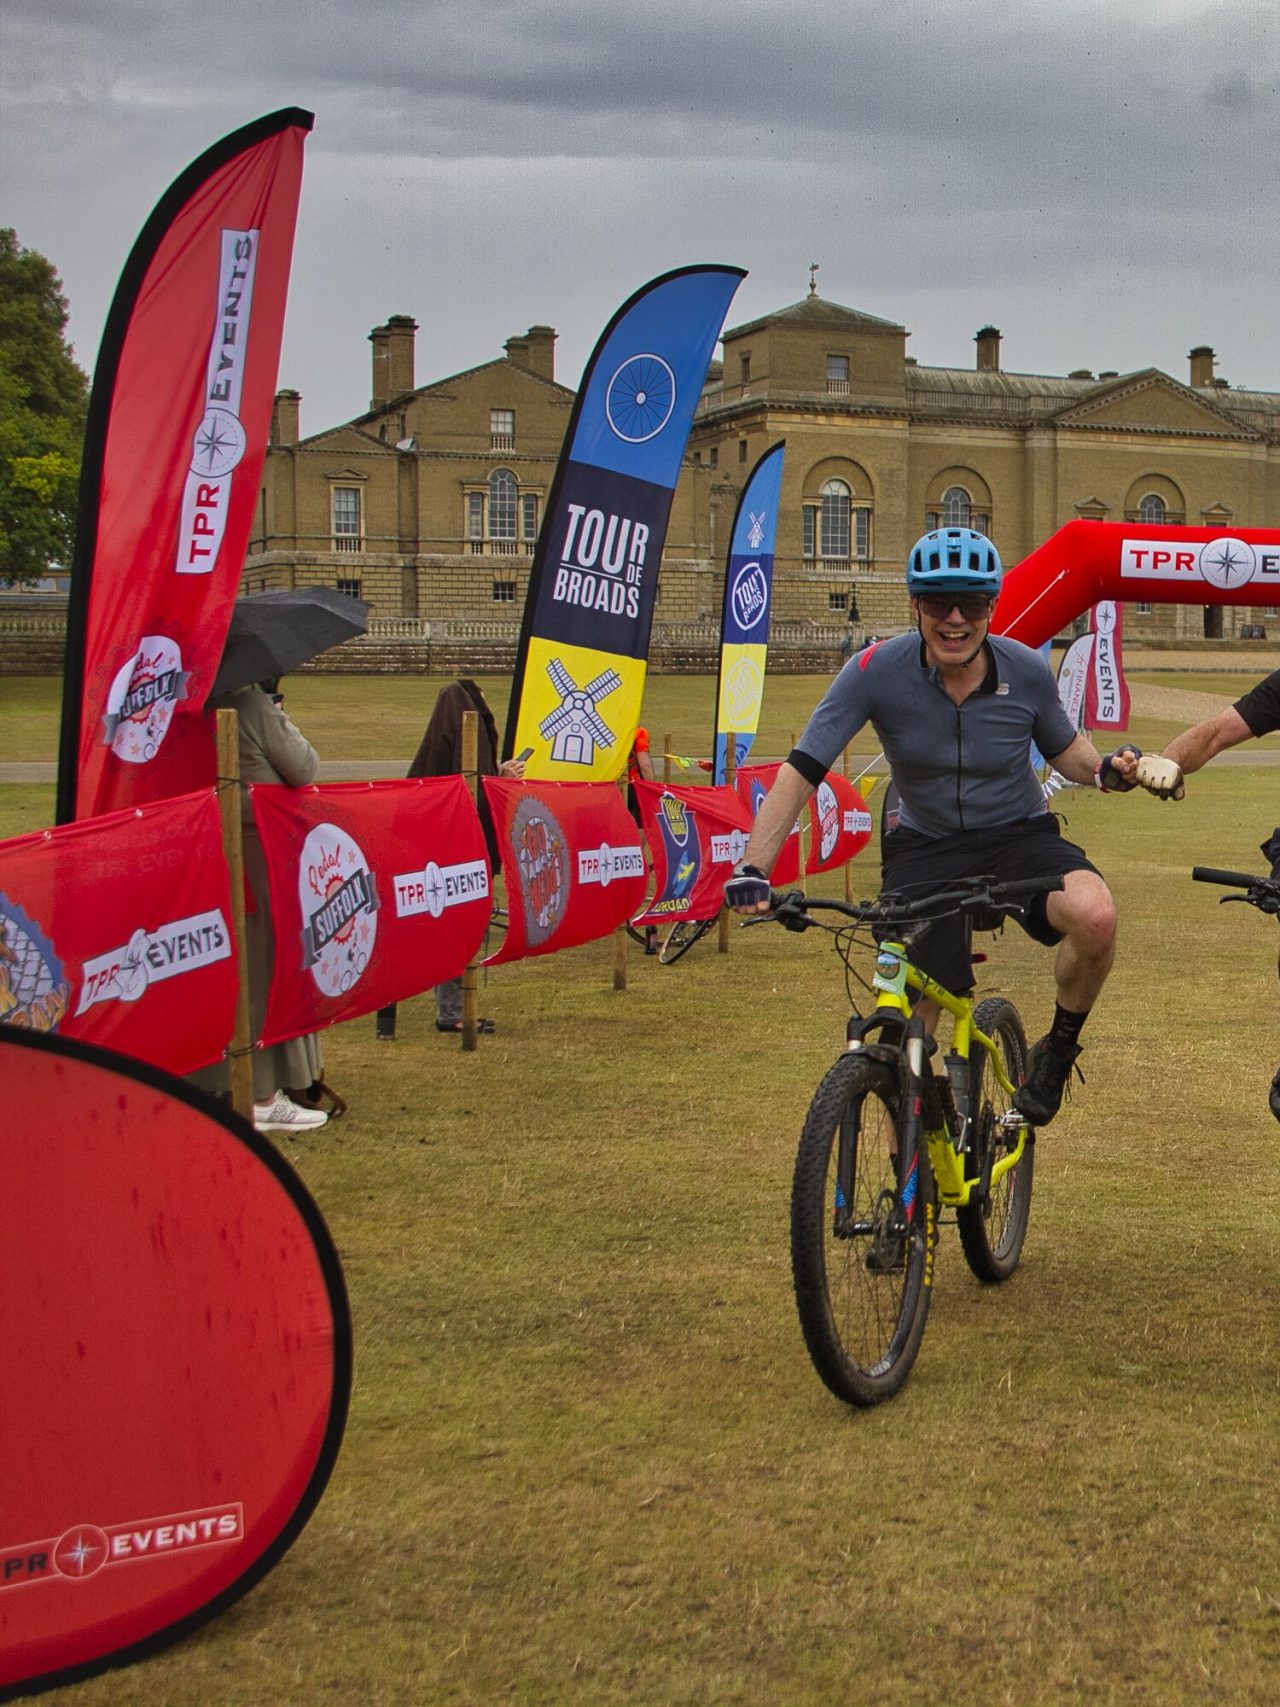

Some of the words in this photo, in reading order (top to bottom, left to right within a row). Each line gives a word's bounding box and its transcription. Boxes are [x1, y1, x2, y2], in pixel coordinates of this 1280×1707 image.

[189, 482, 222, 564] TPR
[210, 236, 253, 402] EVENTS
[561, 504, 649, 574] TOUR
[1129, 549, 1195, 571] TPR
[553, 568, 640, 619] BROADS
[626, 563, 643, 586] DE
[132, 652, 164, 672] dal
[1099, 638, 1116, 718] EVENTS
[308, 844, 341, 896] Pedal
[581, 857, 599, 876] TPR
[614, 854, 643, 872] EVENTS
[713, 842, 729, 857] TPR
[315, 876, 365, 942] SUFFOLK
[398, 882, 425, 907] TPR
[446, 870, 487, 897] EVENTS
[148, 923, 225, 969] EVENTS
[0, 1552, 48, 1579] PR
[112, 1513, 238, 1556] EVENTS
